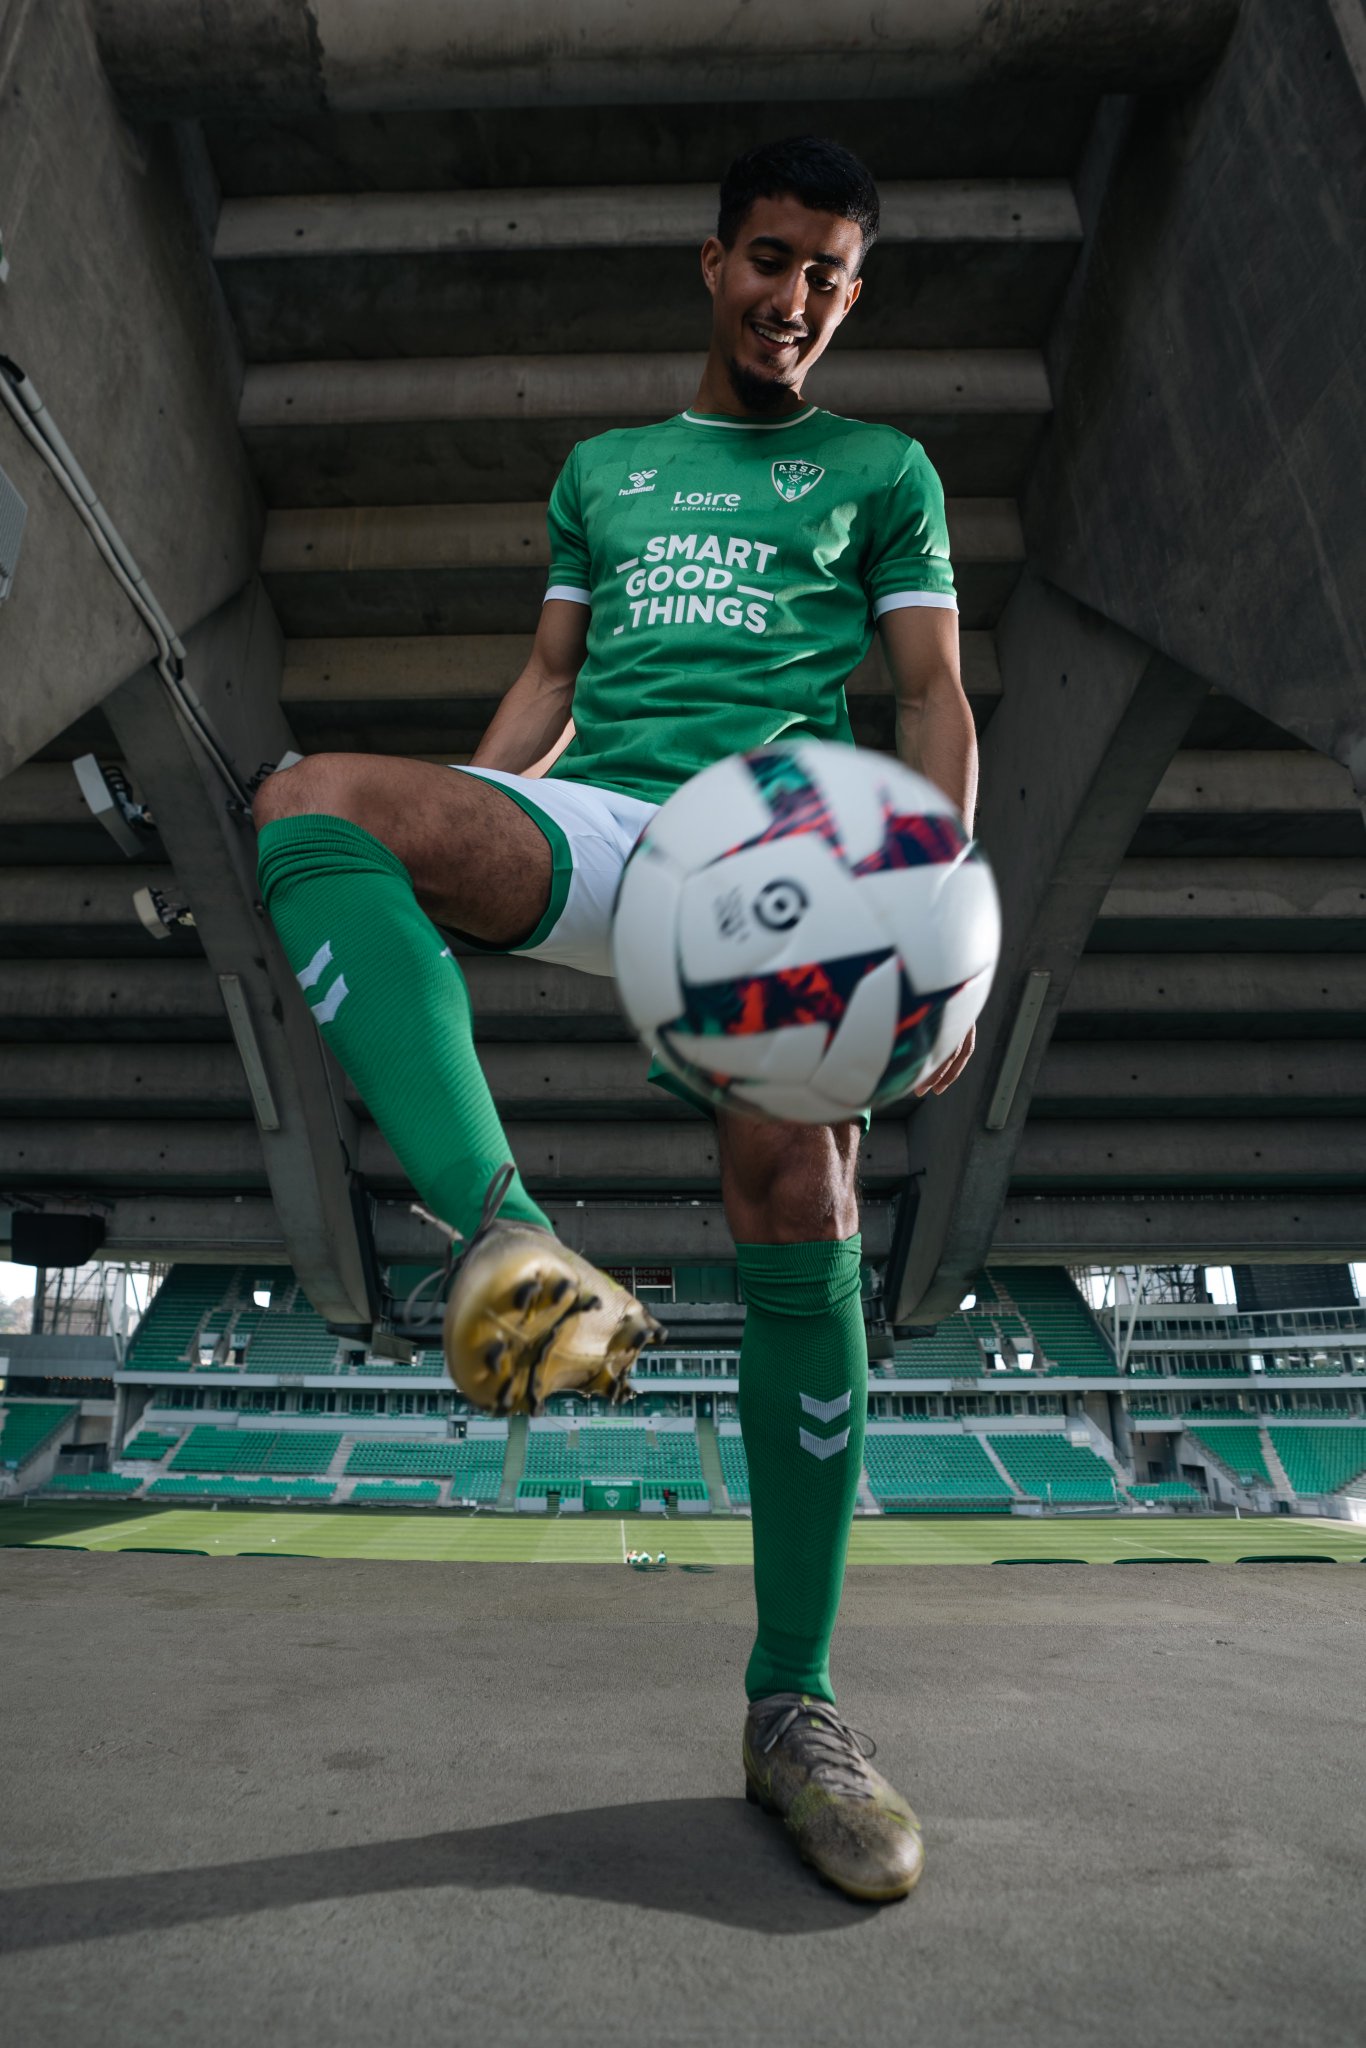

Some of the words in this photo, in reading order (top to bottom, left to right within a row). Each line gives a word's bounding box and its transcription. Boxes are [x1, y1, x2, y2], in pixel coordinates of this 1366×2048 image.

[779, 464, 819, 476] ASSE
[618, 484, 656, 496] hummel
[673, 491, 741, 507] Loire
[643, 534, 778, 574] SMART
[625, 564, 733, 597] GOOD
[629, 594, 768, 634] THINGS
